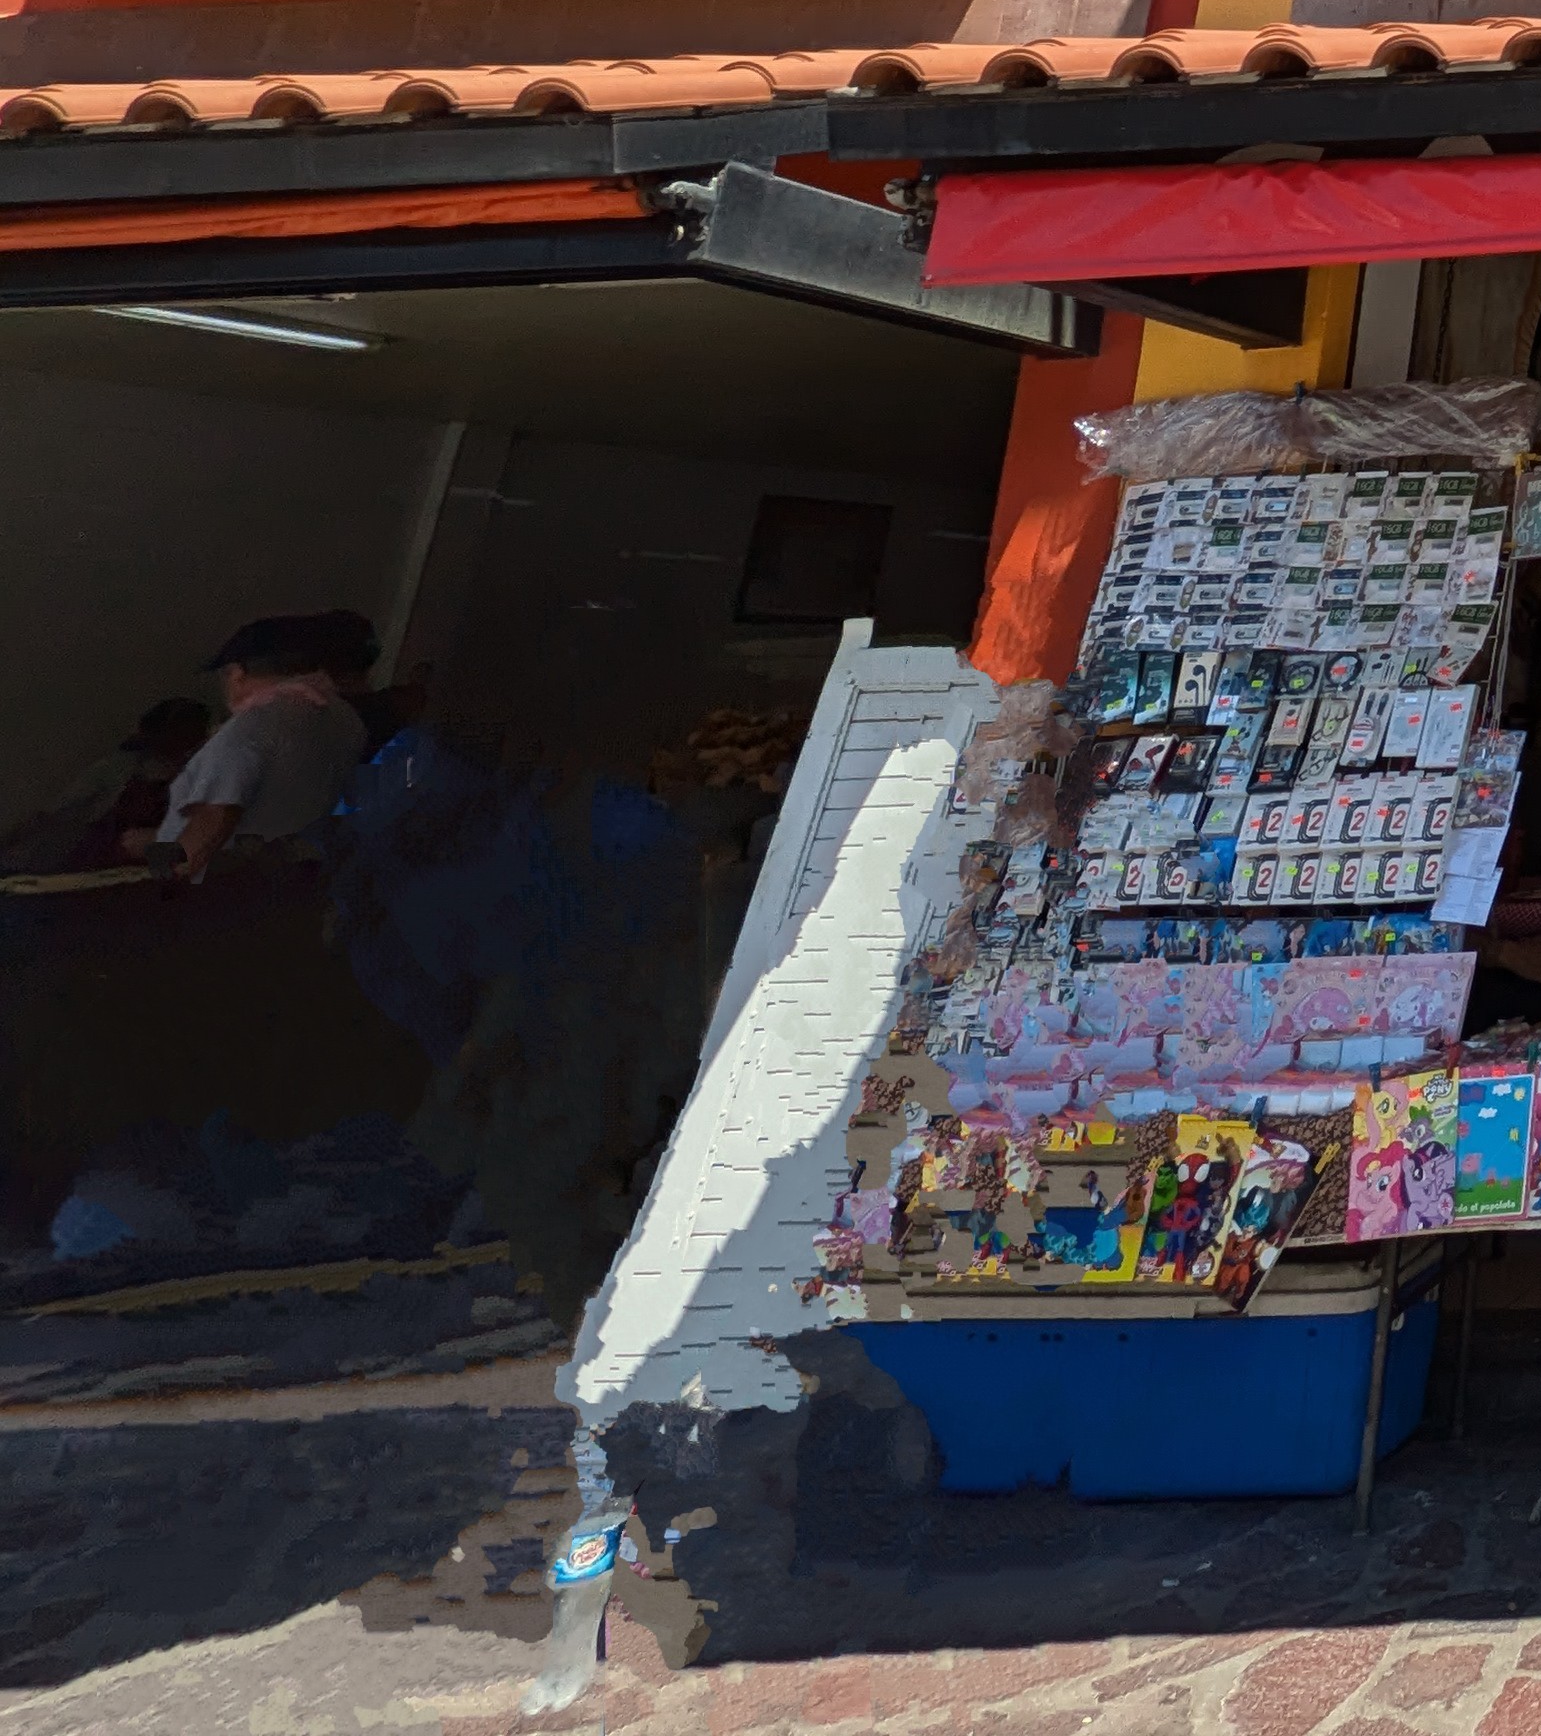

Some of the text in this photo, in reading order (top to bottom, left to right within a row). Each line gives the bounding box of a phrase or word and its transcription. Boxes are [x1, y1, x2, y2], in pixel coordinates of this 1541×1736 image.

[1257, 867, 1273, 889] 2
[1299, 866, 1315, 888] 2
[1343, 865, 1358, 887] 2
[1384, 864, 1400, 886] 2
[1424, 861, 1440, 883] 2
